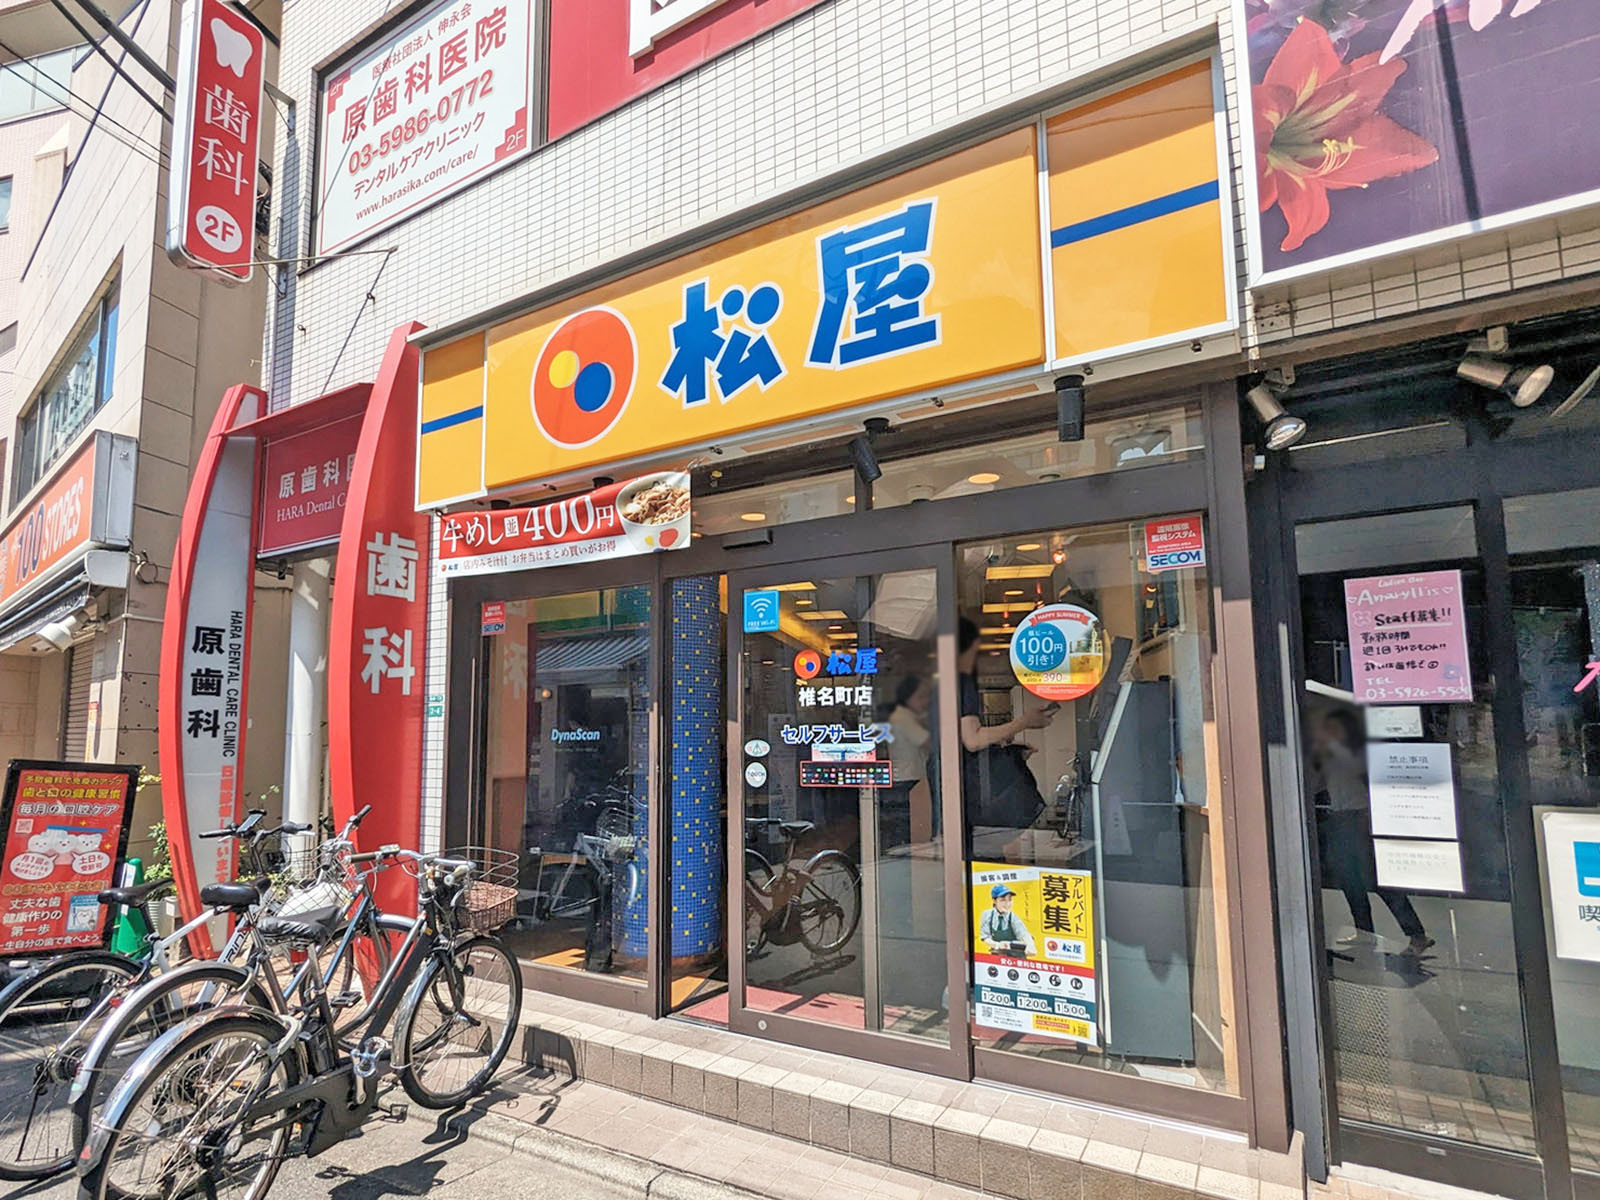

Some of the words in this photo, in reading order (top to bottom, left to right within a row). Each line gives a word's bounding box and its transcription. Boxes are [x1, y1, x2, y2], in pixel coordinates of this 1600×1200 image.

[342, 6, 507, 144] 原歯科医院
[349, 69, 494, 175] 03-5986-0772
[198, 84, 252, 195] 歯科
[506, 128, 525, 151] 2F
[354, 112, 485, 200] デンタルケアクリニック
[356, 144, 479, 220] www.harasika.com/care/
[204, 214, 236, 243] 2F
[657, 196, 942, 409] 松屋
[276, 504, 304, 523] HARA
[306, 494, 335, 515] Dental
[512, 540, 616, 564] お弁当はまとめ買いがお得
[1150, 550, 1201, 567] SECOM
[1357, 586, 1440, 605] Amaryllis
[229, 610, 244, 640] HARA
[361, 530, 418, 695] 歯科
[1020, 636, 1063, 654] 100円
[227, 642, 241, 685] DENTAL
[826, 648, 879, 675] 松屋
[187, 626, 226, 738] 原歯科
[1043, 672, 1063, 682] 390
[225, 688, 239, 718] CARE
[799, 685, 873, 707] 椎名町店
[222, 720, 237, 758] CLINIC
[551, 728, 600, 744] DynaScan
[782, 724, 895, 743] セルフサービス
[80, 854, 104, 865] 土日も
[2, 909, 63, 925] 健康作りの
[9, 896, 61, 911] 丈夫な歯
[1042, 875, 1071, 932] 募集
[1072, 877, 1084, 934] アルバイト
[11, 923, 50, 938] 第一歩
